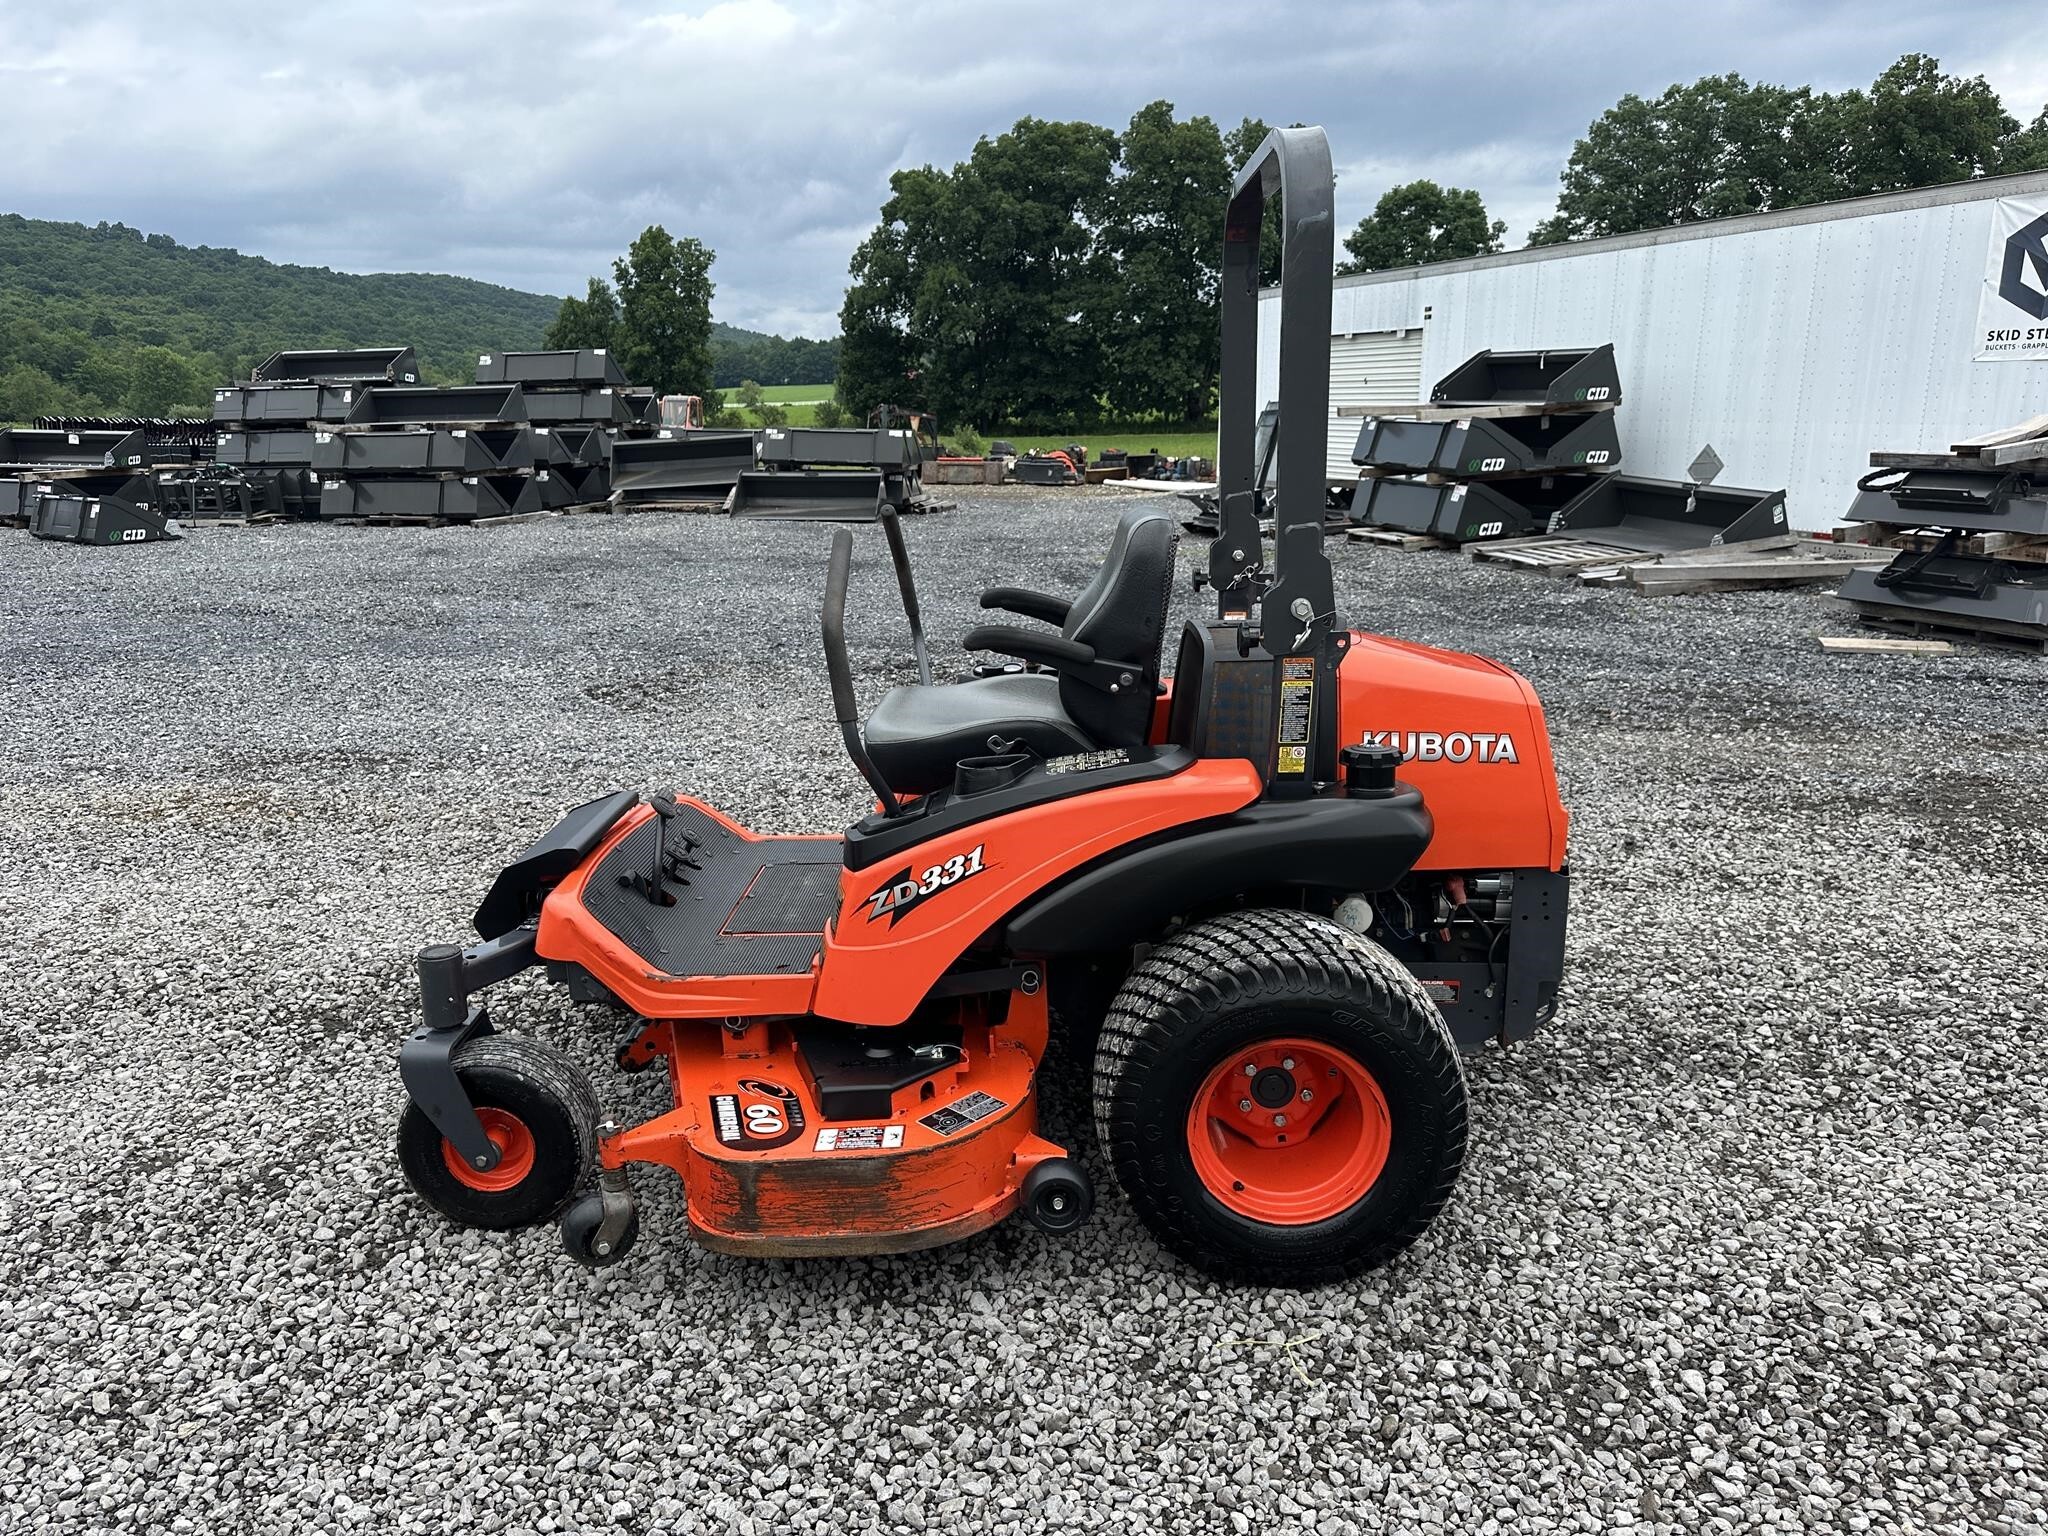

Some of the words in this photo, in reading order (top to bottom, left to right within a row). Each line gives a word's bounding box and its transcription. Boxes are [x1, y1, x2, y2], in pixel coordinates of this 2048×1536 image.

[1987, 329, 2021, 342] SKID
[1985, 343, 2016, 351] BUCKETS
[1586, 387, 1610, 401] CID
[128, 455, 141, 465] CID
[1585, 450, 1610, 464] CID
[1481, 458, 1506, 471] CID
[122, 529, 146, 541] CID
[1478, 522, 1503, 537] CID
[867, 844, 985, 921] ZD331
[715, 1095, 741, 1142] COMMERCIAL
[745, 1103, 784, 1134] 60
